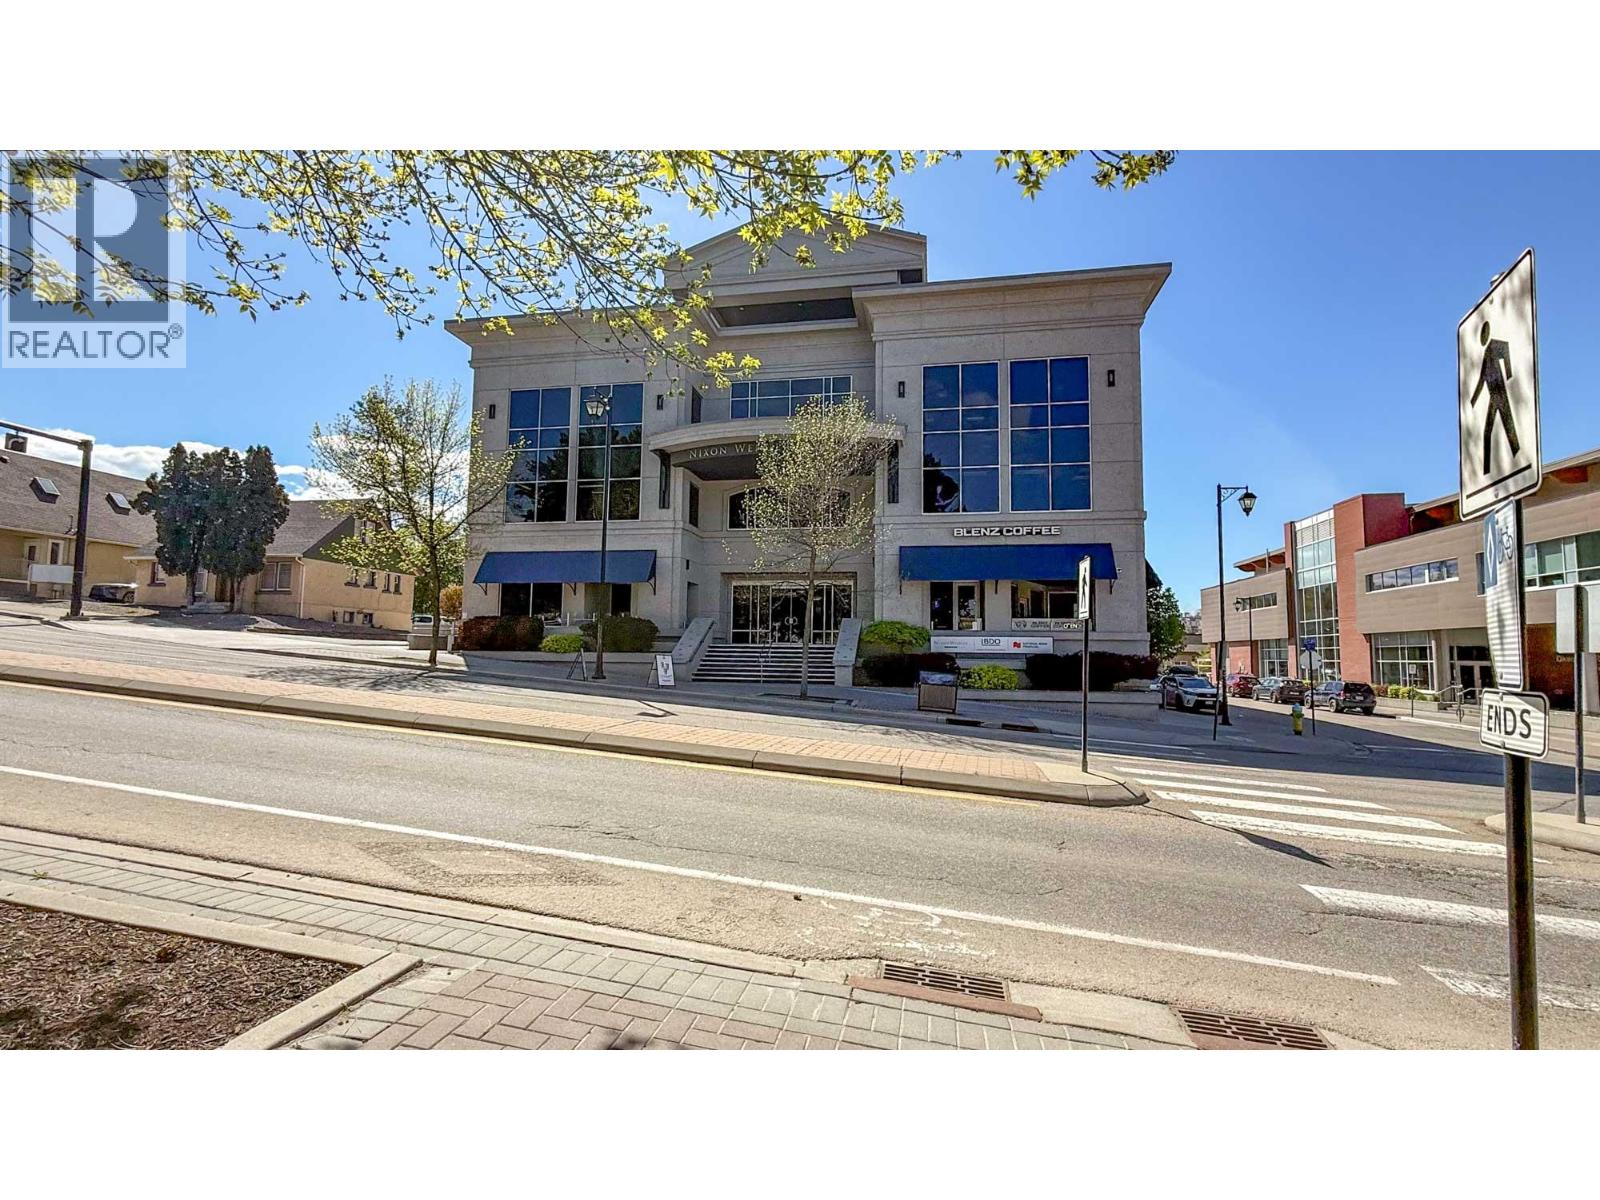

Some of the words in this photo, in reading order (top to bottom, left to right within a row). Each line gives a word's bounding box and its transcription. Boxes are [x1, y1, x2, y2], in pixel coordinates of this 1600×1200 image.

[689, 446, 728, 459] NIXON
[953, 527, 1001, 538] BLENZ
[1003, 526, 1061, 536] COFFEE
[1486, 704, 1532, 740] ENDS
